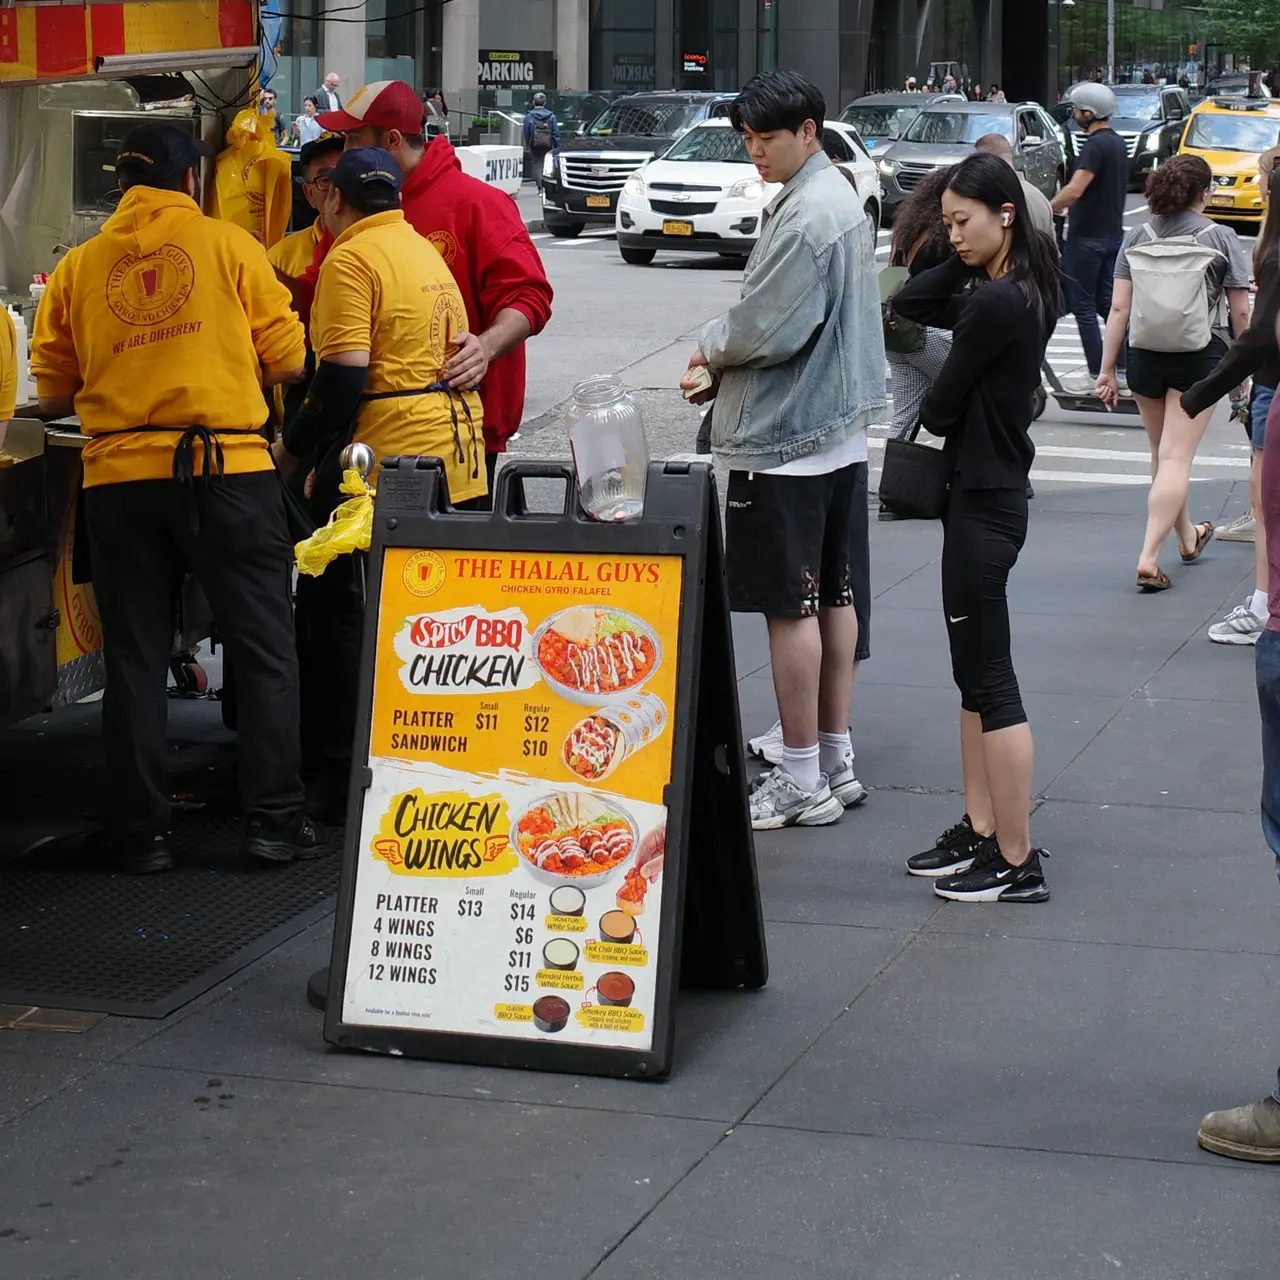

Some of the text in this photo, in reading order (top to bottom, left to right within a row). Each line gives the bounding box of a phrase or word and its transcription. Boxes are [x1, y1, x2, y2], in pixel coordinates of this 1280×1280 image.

[490, 158, 518, 181] NYPD
[110, 266, 126, 291] THE
[114, 283, 189, 321] GYRO CHICKEN
[112, 321, 203, 355] WE ARE DIFFERENT
[454, 558, 502, 579] THE
[508, 559, 592, 582] HALAL
[501, 584, 612, 597] CHICKEN GYRO FALAFEL
[475, 618, 523, 652] BBQ
[410, 654, 526, 688] CHICKEN
[393, 710, 549, 733] PLATTER $11 $12
[480, 701, 551, 714] Small Regular
[391, 733, 548, 758] SANDWICH $10
[403, 837, 482, 871] WINGS
[376, 893, 536, 921] PLATTER $13 $14
[465, 886, 537, 900] Small Regular
[373, 917, 533, 945] 4 WINGS $6
[371, 940, 532, 969] 8 WINGS $11
[369, 963, 530, 993] 12 WINGS $15
